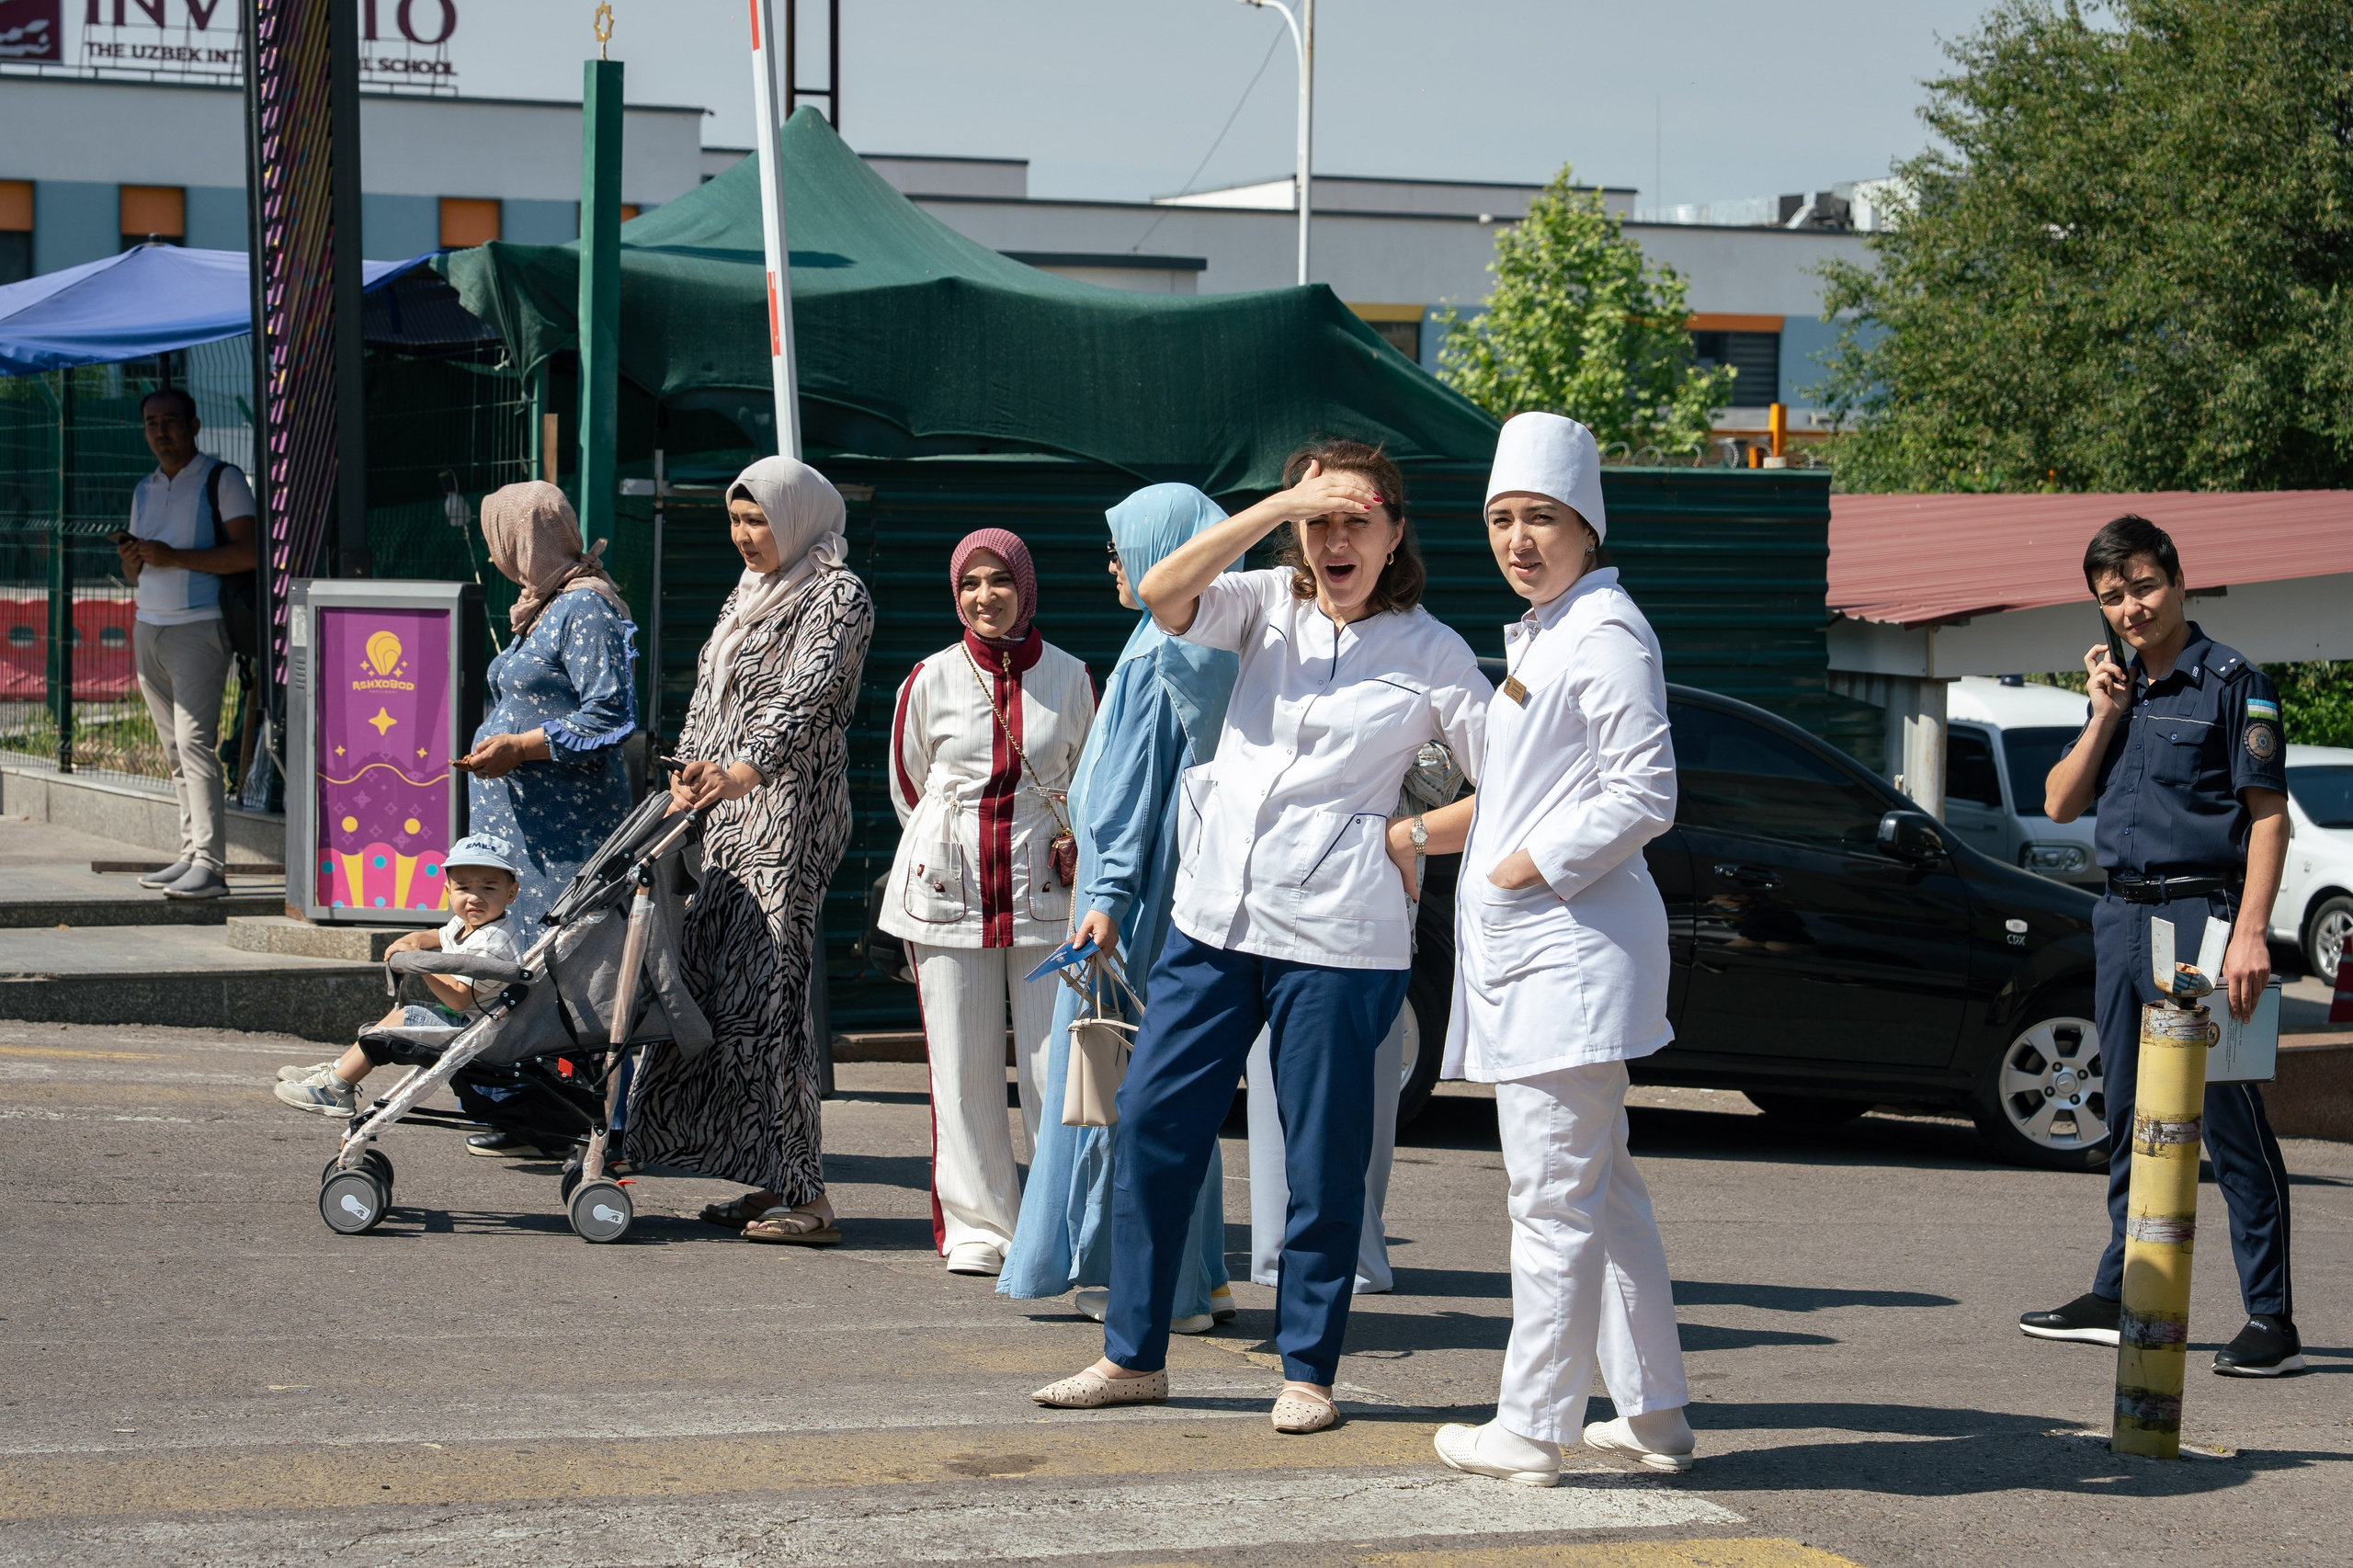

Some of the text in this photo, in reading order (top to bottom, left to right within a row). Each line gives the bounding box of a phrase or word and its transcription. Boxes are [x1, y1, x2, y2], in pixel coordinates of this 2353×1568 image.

[85, 42, 125, 58] THE
[131, 45, 202, 62] UZBEK
[379, 58, 458, 75] SCHOOL
[352, 679, 415, 691] ASHXOBOD
[465, 842, 497, 853] SMILE
[2006, 934, 2026, 946] CDX
[2250, 1320, 2268, 1331] BOSS
